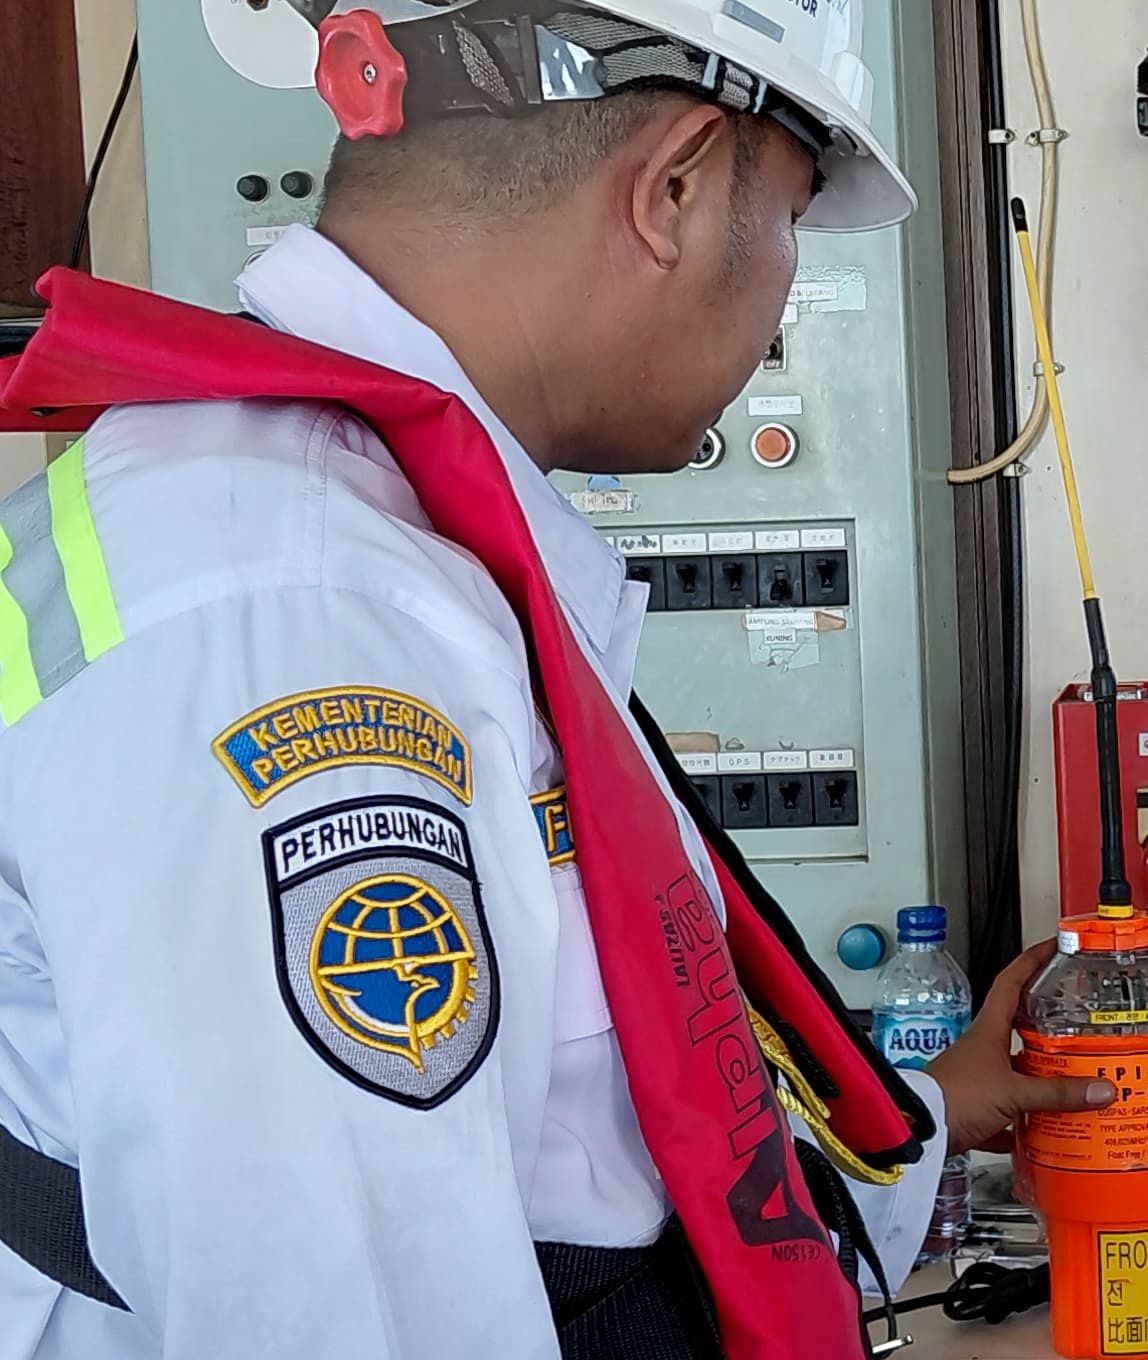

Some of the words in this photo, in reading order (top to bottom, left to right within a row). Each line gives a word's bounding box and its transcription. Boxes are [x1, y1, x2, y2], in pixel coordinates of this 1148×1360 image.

[248, 698, 451, 751] KEMENTERIAN
[251, 726, 462, 784] PERHUBUNGAN
[281, 811, 465, 873] PERHUBUNGAN
[889, 1028, 951, 1054] AQUA
